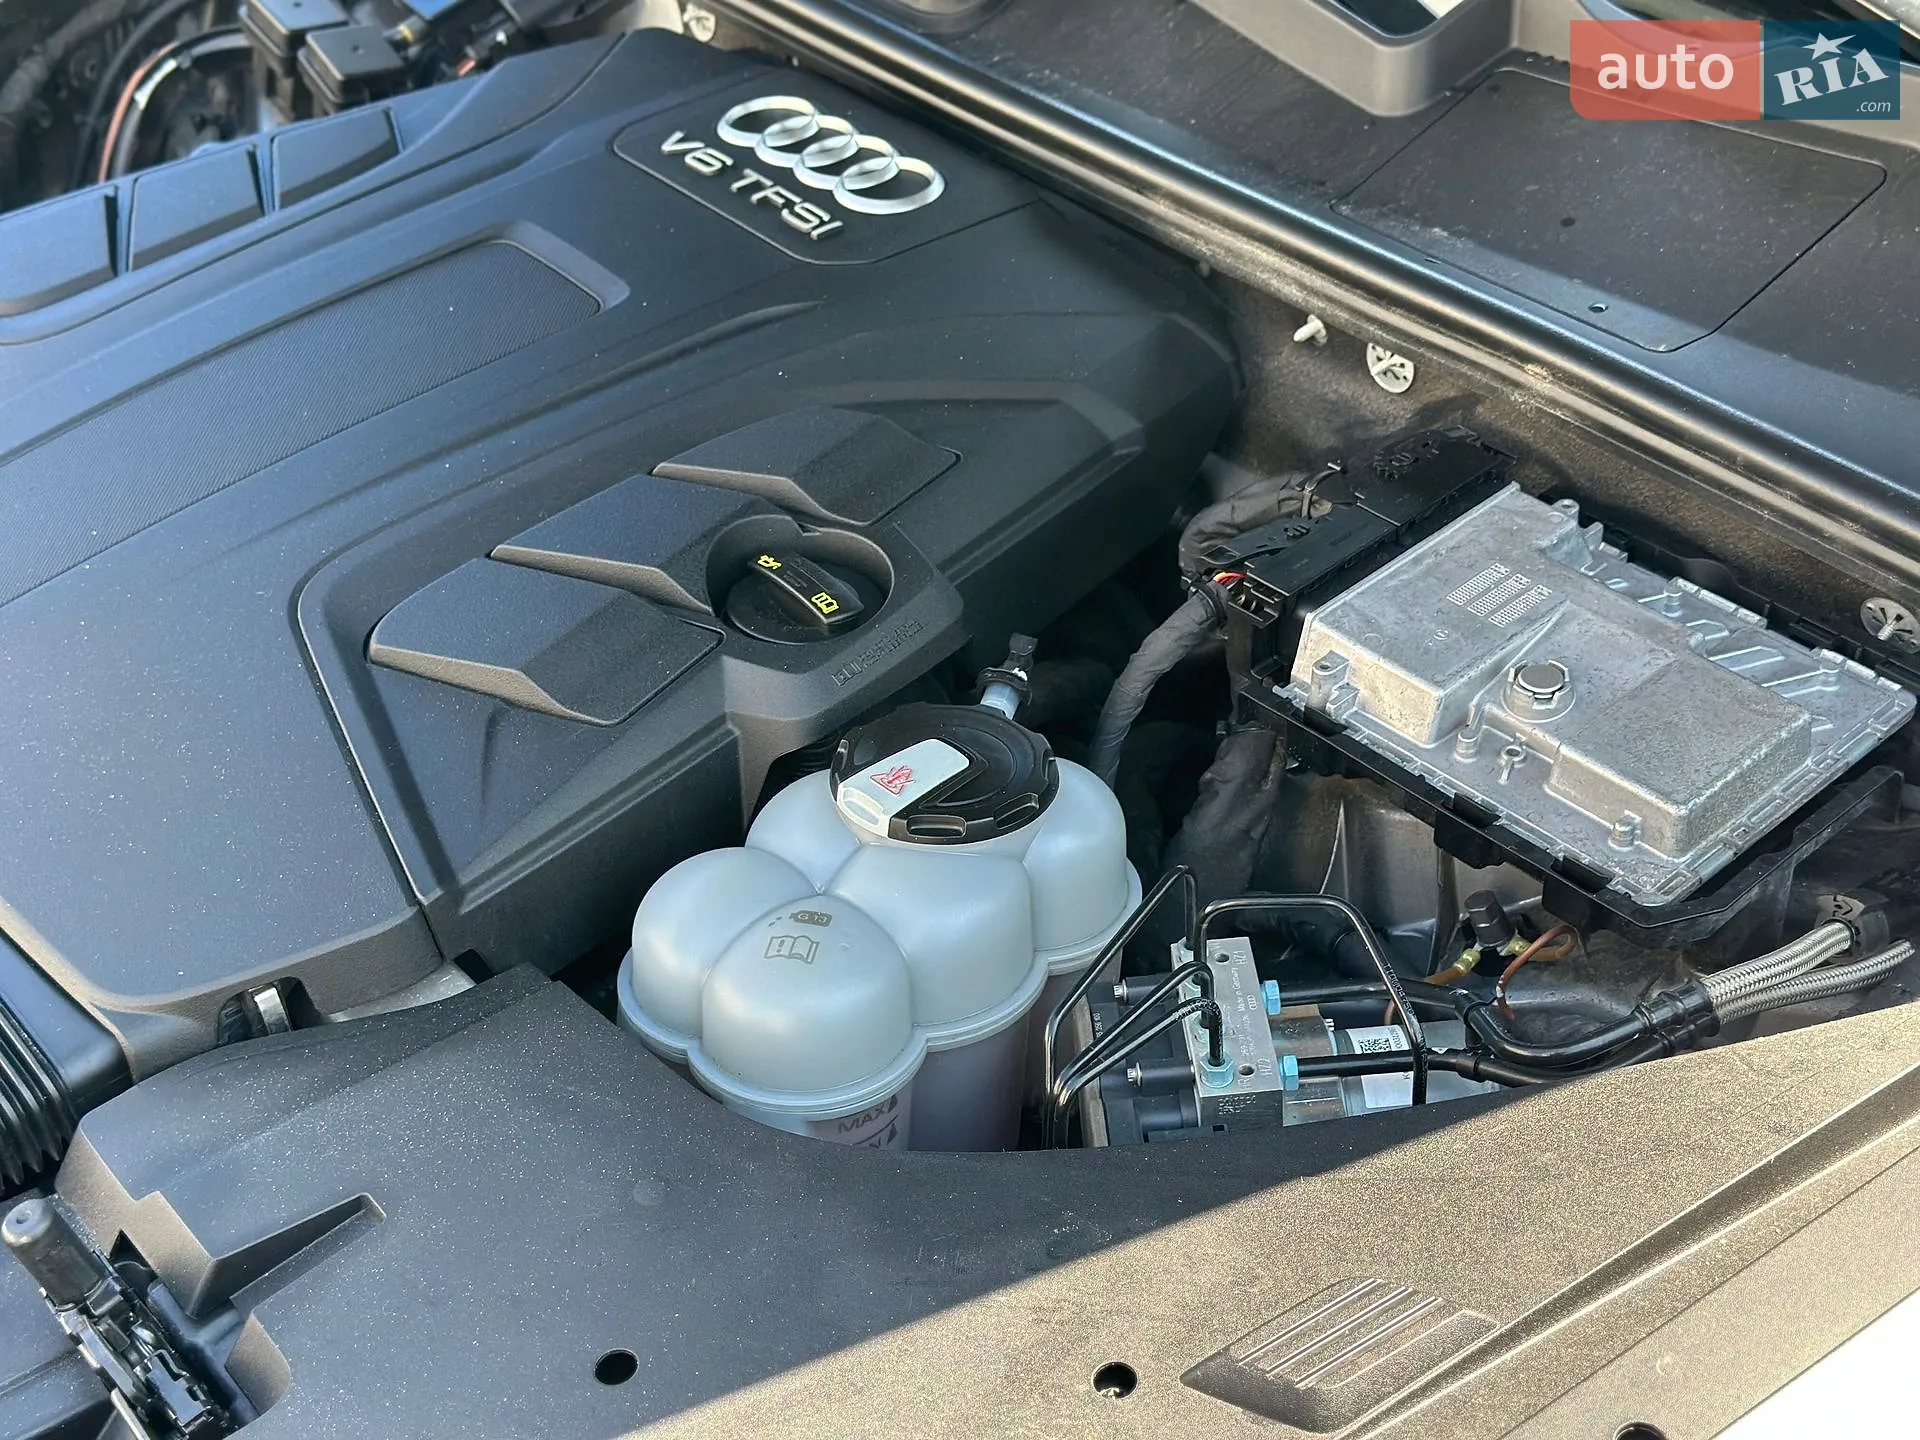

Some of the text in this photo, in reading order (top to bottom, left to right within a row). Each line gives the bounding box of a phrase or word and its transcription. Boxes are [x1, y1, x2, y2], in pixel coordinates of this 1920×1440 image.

[661, 130, 844, 241] V6 TFSI
[838, 1103, 885, 1134] MAX
